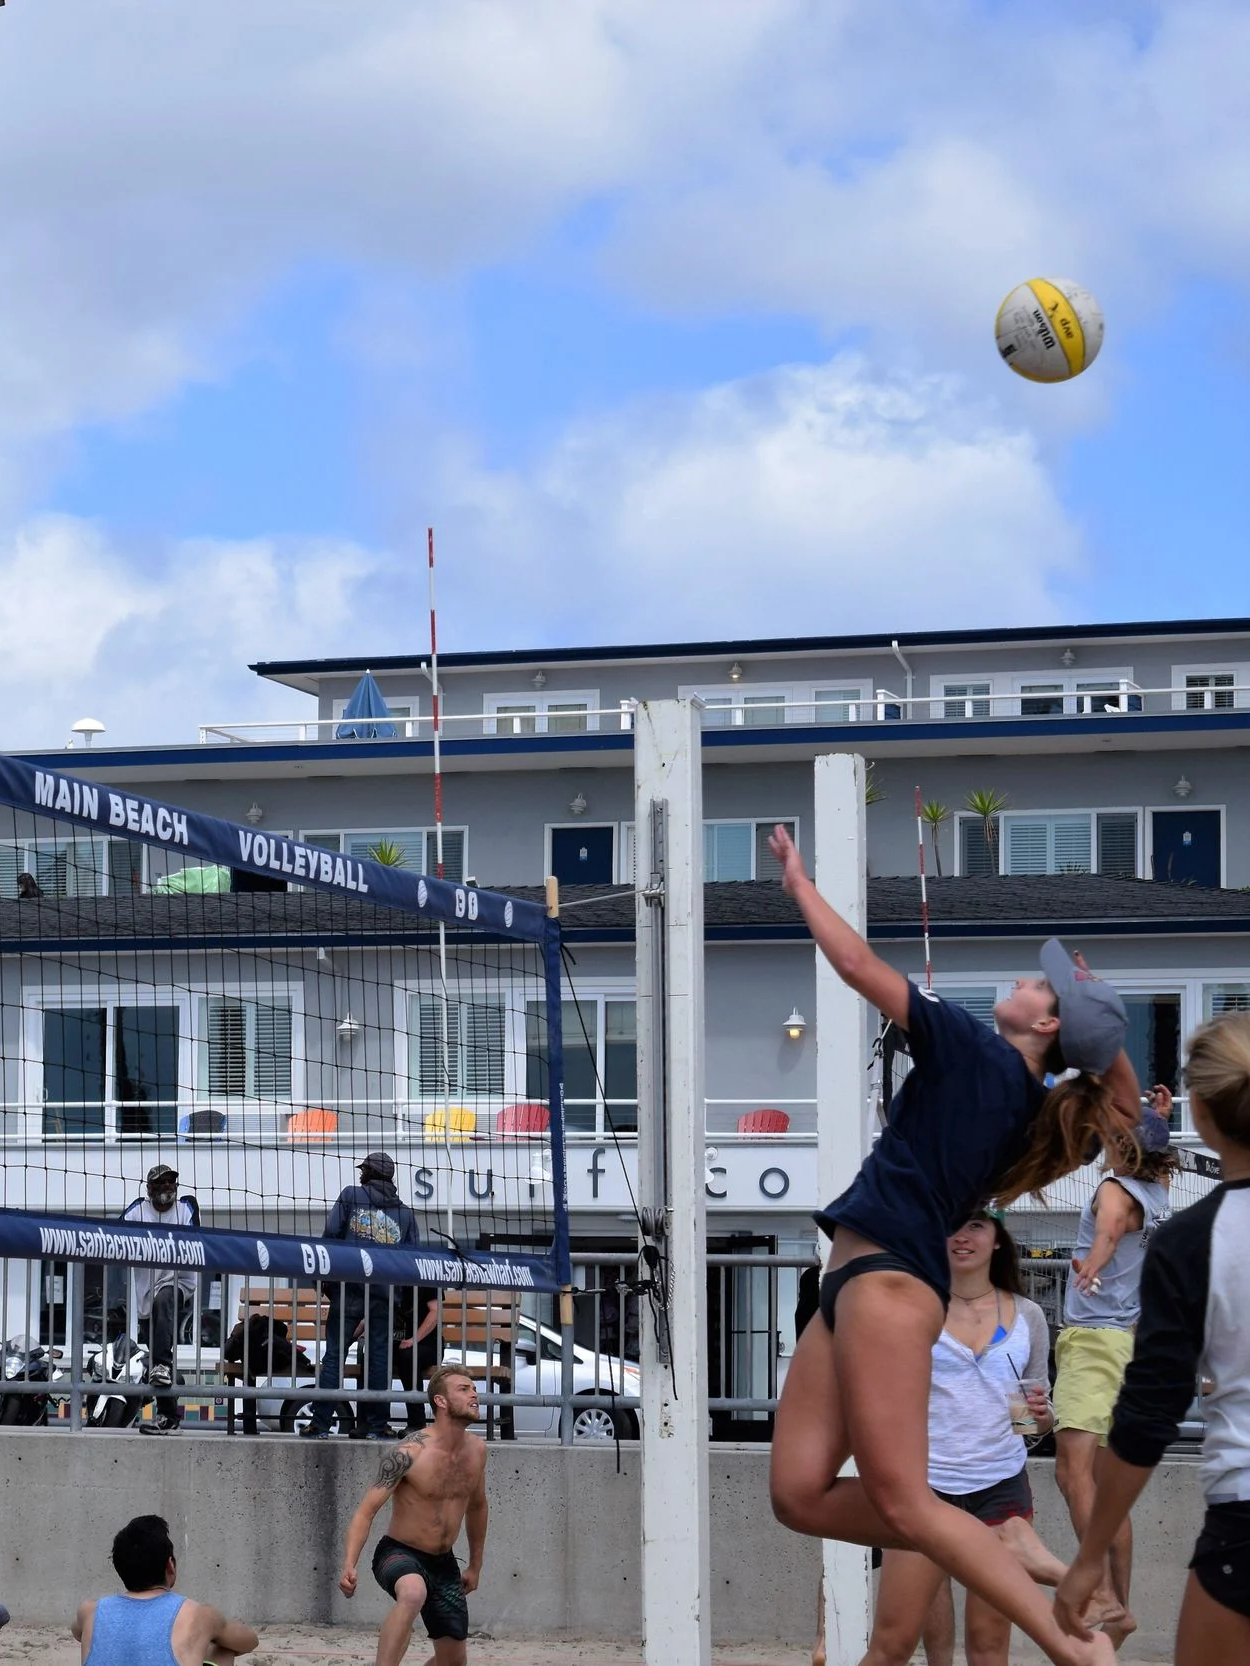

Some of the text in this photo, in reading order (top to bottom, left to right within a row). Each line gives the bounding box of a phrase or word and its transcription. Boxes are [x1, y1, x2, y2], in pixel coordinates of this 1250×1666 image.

[34, 771, 99, 820] MAIN
[108, 793, 189, 845] BEACH
[238, 830, 369, 893] VOLLEYBALL
[39, 1227, 206, 1266] www.santacruzwharf.com
